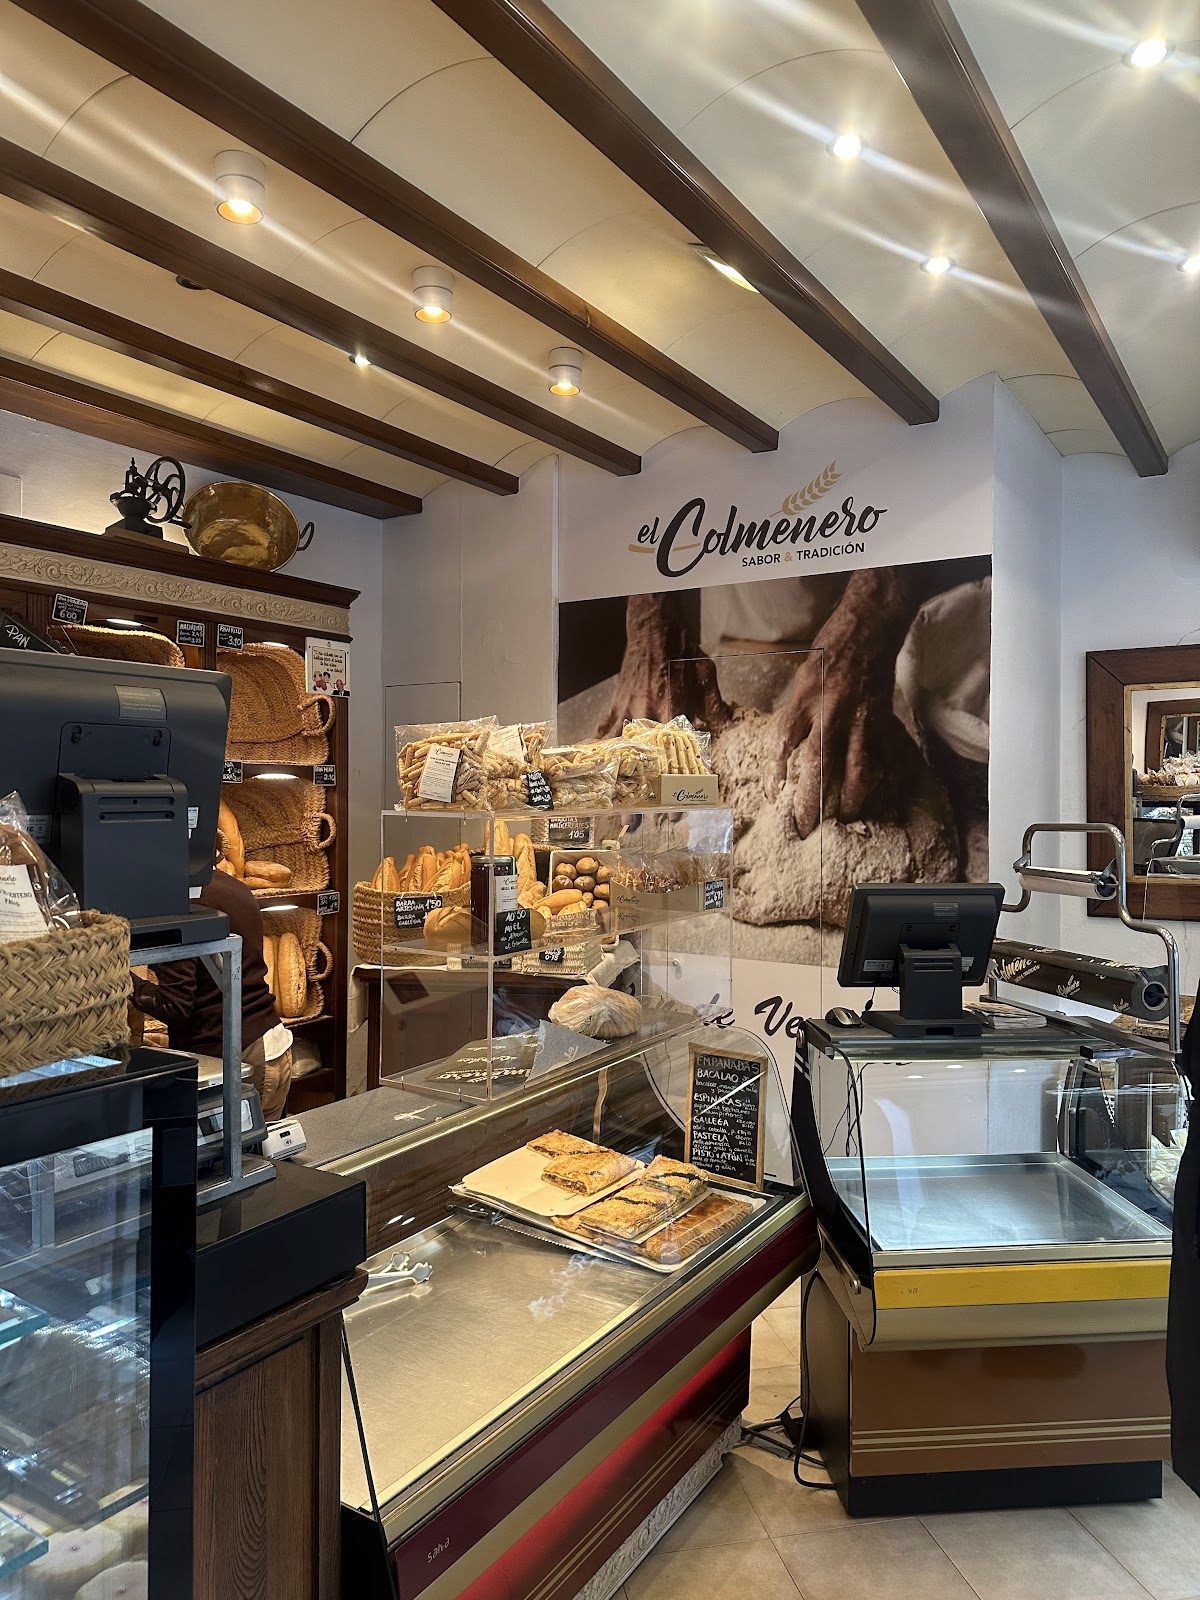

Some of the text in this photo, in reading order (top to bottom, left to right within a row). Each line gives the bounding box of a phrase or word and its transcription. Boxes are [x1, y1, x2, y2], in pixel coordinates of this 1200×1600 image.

[637, 497, 888, 577] el Colmenero
[742, 541, 865, 567] SABOR & TRADICIÓN
[4, 624, 31, 648] PAN
[697, 1055, 760, 1075] EMPANADAS
[697, 1068, 739, 1082] BACALAO
[693, 1130, 729, 1142] PASTELA
[692, 1147, 714, 1158] PISTO
[720, 1151, 743, 1162] ATÚN
